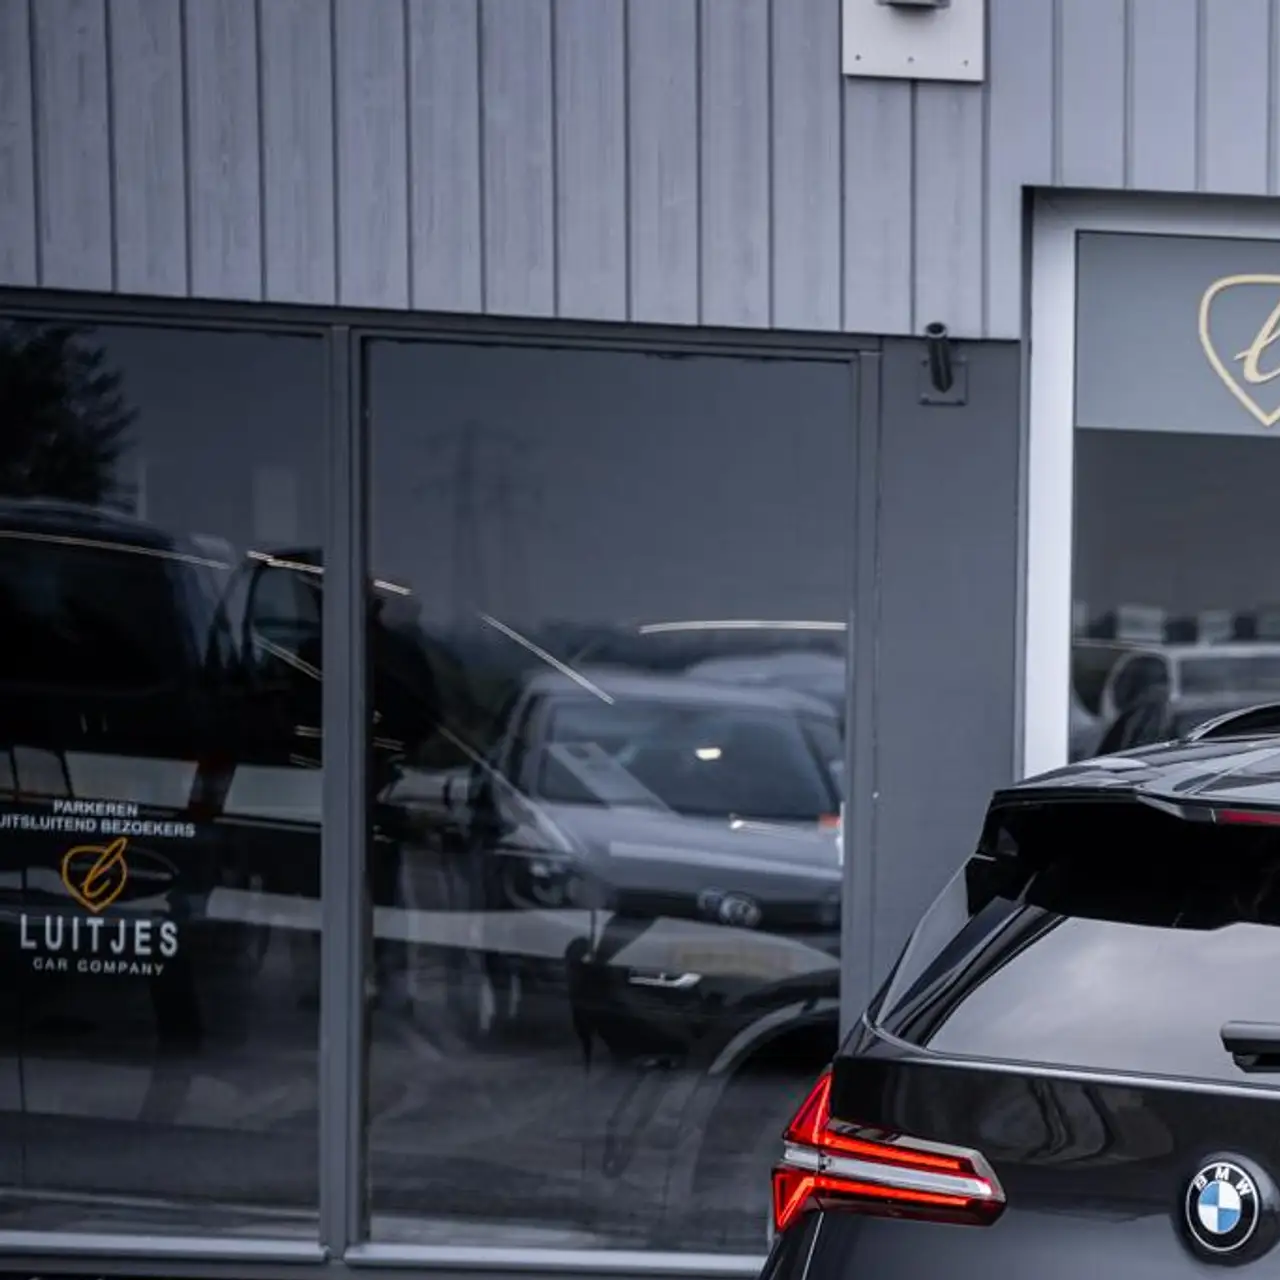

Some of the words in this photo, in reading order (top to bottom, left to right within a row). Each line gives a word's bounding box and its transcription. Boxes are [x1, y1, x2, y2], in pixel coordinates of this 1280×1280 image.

[53, 799, 139, 817] PARKEREN
[100, 818, 196, 838] BEZOEKERS
[20, 913, 179, 957] LUITJES
[33, 957, 68, 972] CAR
[77, 959, 165, 976] COMPANY
[1193, 1166, 1252, 1196] BMW
